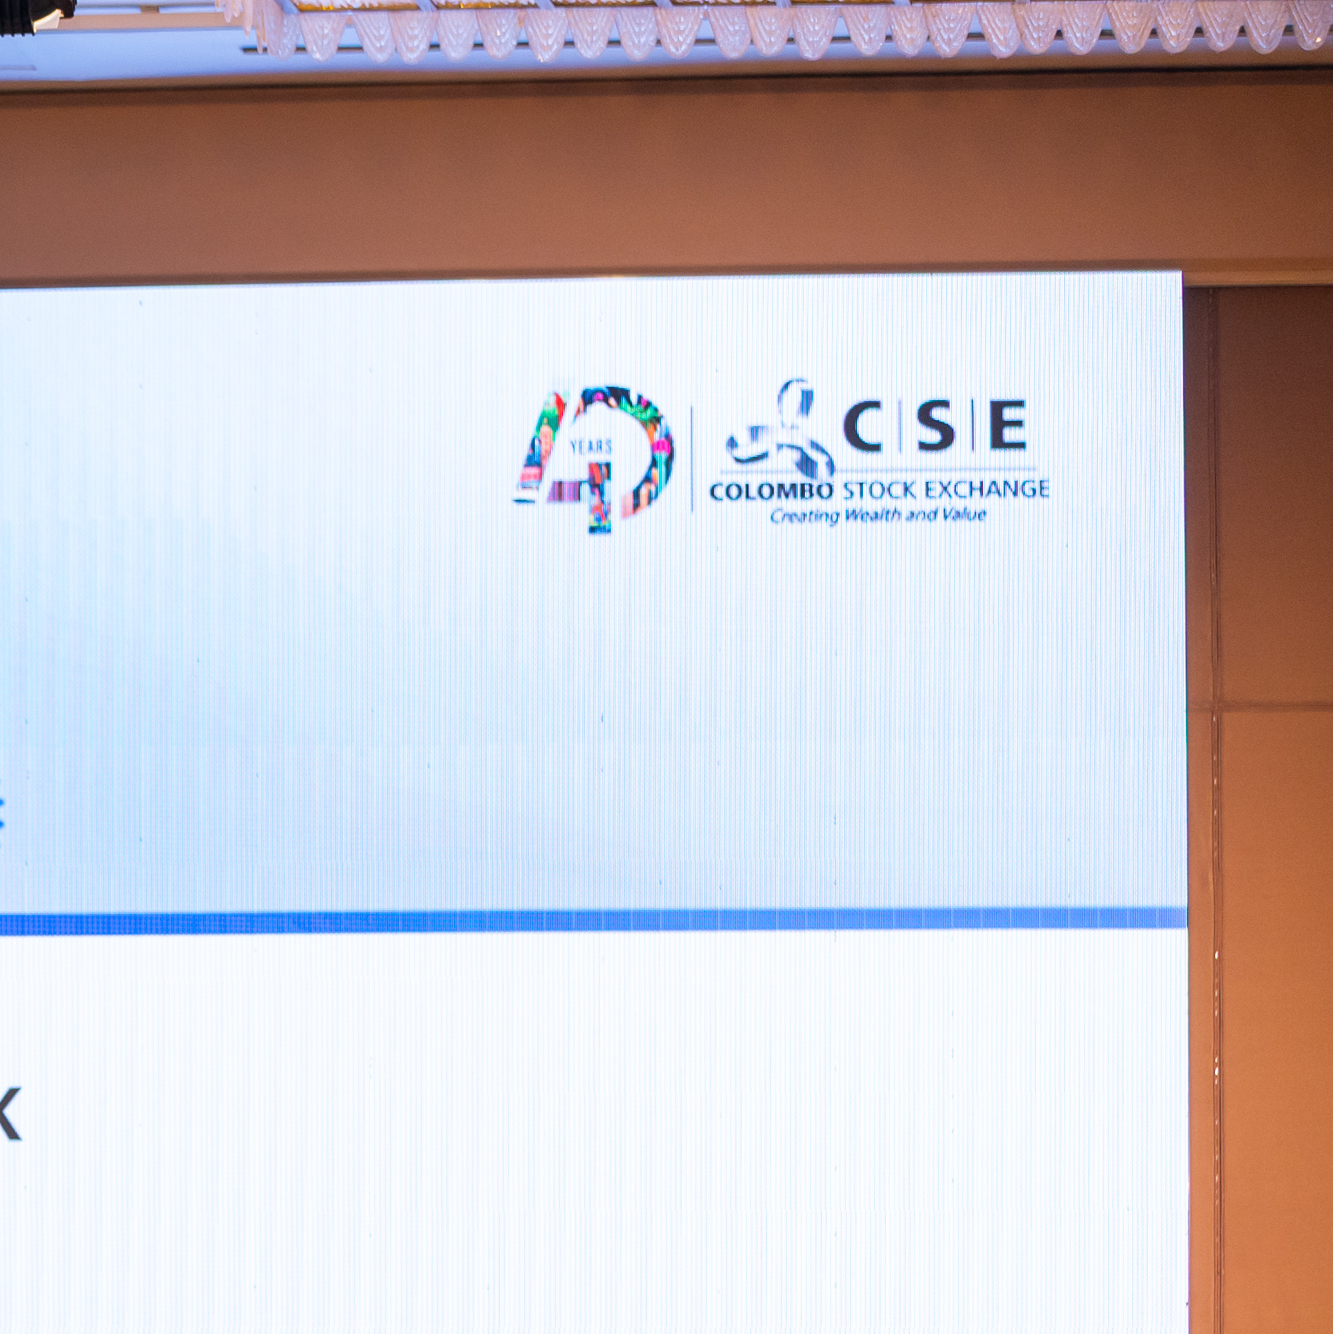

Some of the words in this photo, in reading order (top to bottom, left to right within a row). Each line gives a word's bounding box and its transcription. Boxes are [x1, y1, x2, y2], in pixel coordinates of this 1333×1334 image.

[570, 438, 613, 456] YEARS
[709, 482, 835, 501] COLOMBO
[843, 480, 918, 501] STOCK
[925, 478, 1051, 500] EXCHANGE
[770, 506, 841, 528] Creating
[844, 505, 902, 524] Wealth
[906, 506, 938, 524] and
[942, 506, 987, 523] Value
